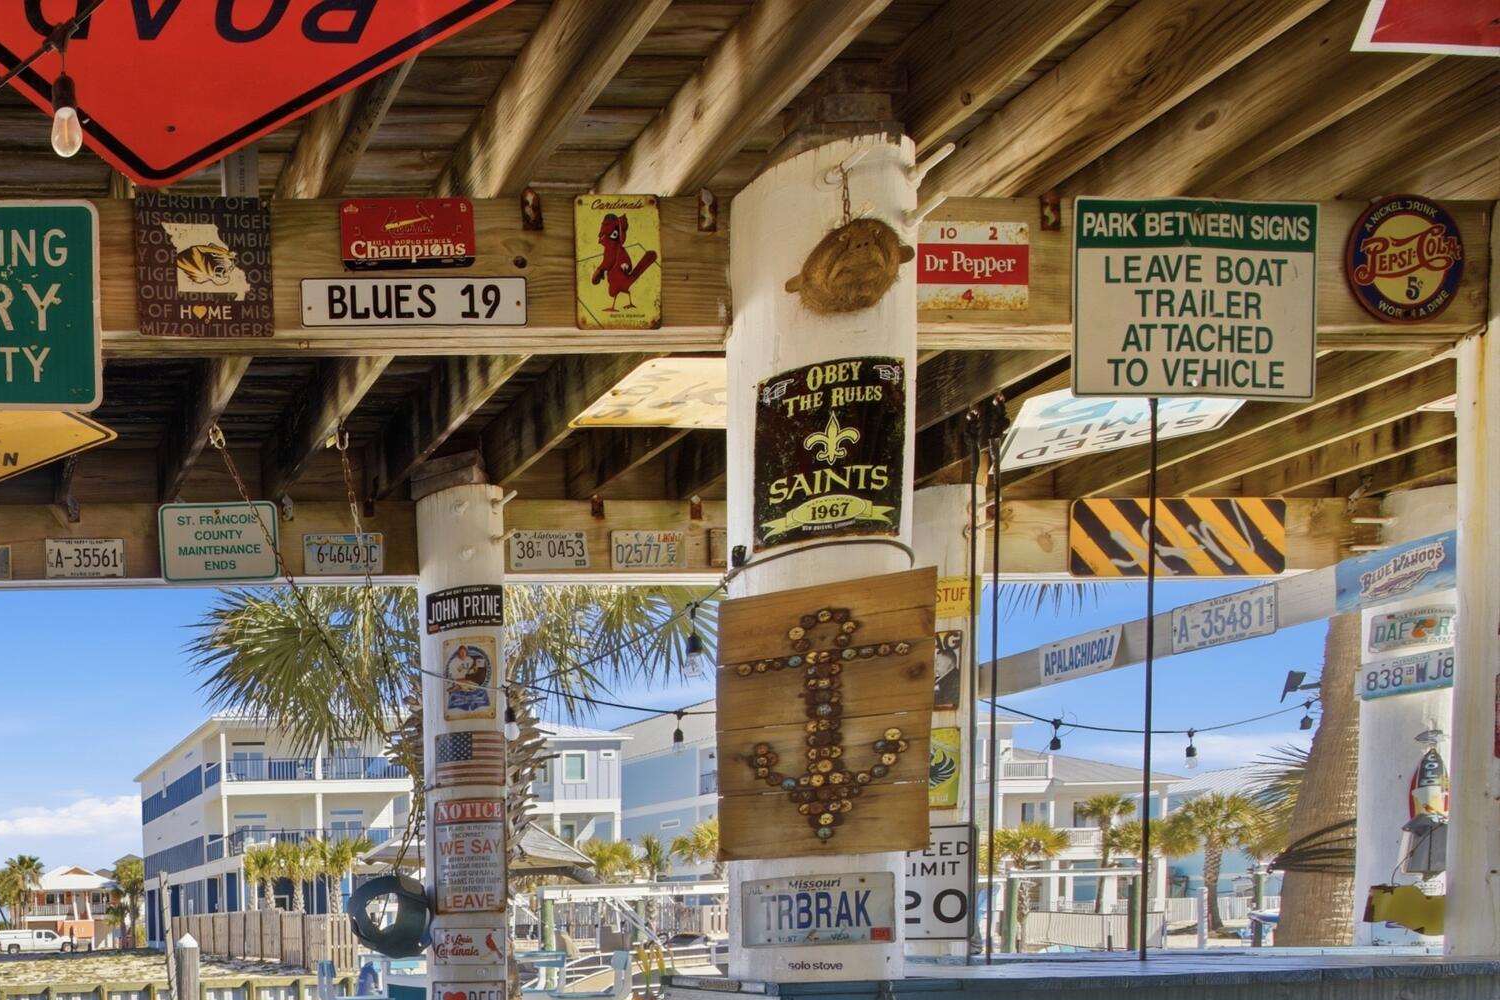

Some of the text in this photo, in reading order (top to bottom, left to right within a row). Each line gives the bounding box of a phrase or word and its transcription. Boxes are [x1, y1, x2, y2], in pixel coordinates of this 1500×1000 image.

[225, 195, 250, 209] OF
[591, 199, 645, 210] Cardinals
[1369, 201, 1404, 224] NICKEL
[939, 227, 998, 241] 10 2
[1083, 212, 1310, 241] PARK BETWEEN SIGNS
[350, 240, 467, 264] Champions
[925, 251, 1017, 280] Dr Pepper
[1104, 255, 1288, 286] LEAVE BOAT
[328, 284, 500, 318] BLUES 19
[963, 289, 974, 300] 4
[1134, 289, 1262, 320] TRAILER
[1427, 289, 1449, 313] DIME
[148, 304, 173, 318] OF
[1121, 324, 1274, 354] ATTACHED
[806, 361, 862, 391] OBEY
[1107, 359, 1285, 389] TO VEHICLE
[783, 385, 883, 418] THE RULES
[769, 465, 889, 505] SAINTS
[177, 514, 258, 526] ST. FRANCOIS
[811, 501, 850, 521] 1967
[195, 530, 243, 541] COUNTY
[55, 547, 118, 568] A-35561
[178, 544, 261, 556] MAINTENANCE
[516, 539, 585, 559] 38 0453
[204, 561, 237, 571] ENDS
[428, 594, 501, 624] JOHN PRINE
[1177, 597, 1265, 644] A-35481
[1044, 634, 1115, 676] APALACHICOLA
[437, 801, 502, 820] NOTICE
[439, 838, 501, 857] WE SAY
[788, 877, 841, 890] Missouri
[444, 893, 496, 909] LEAVE
[760, 890, 872, 930] TRBRAK
[905, 888, 967, 924] 20
[436, 944, 479, 959] Cardinals
[788, 961, 843, 971] solo stove
